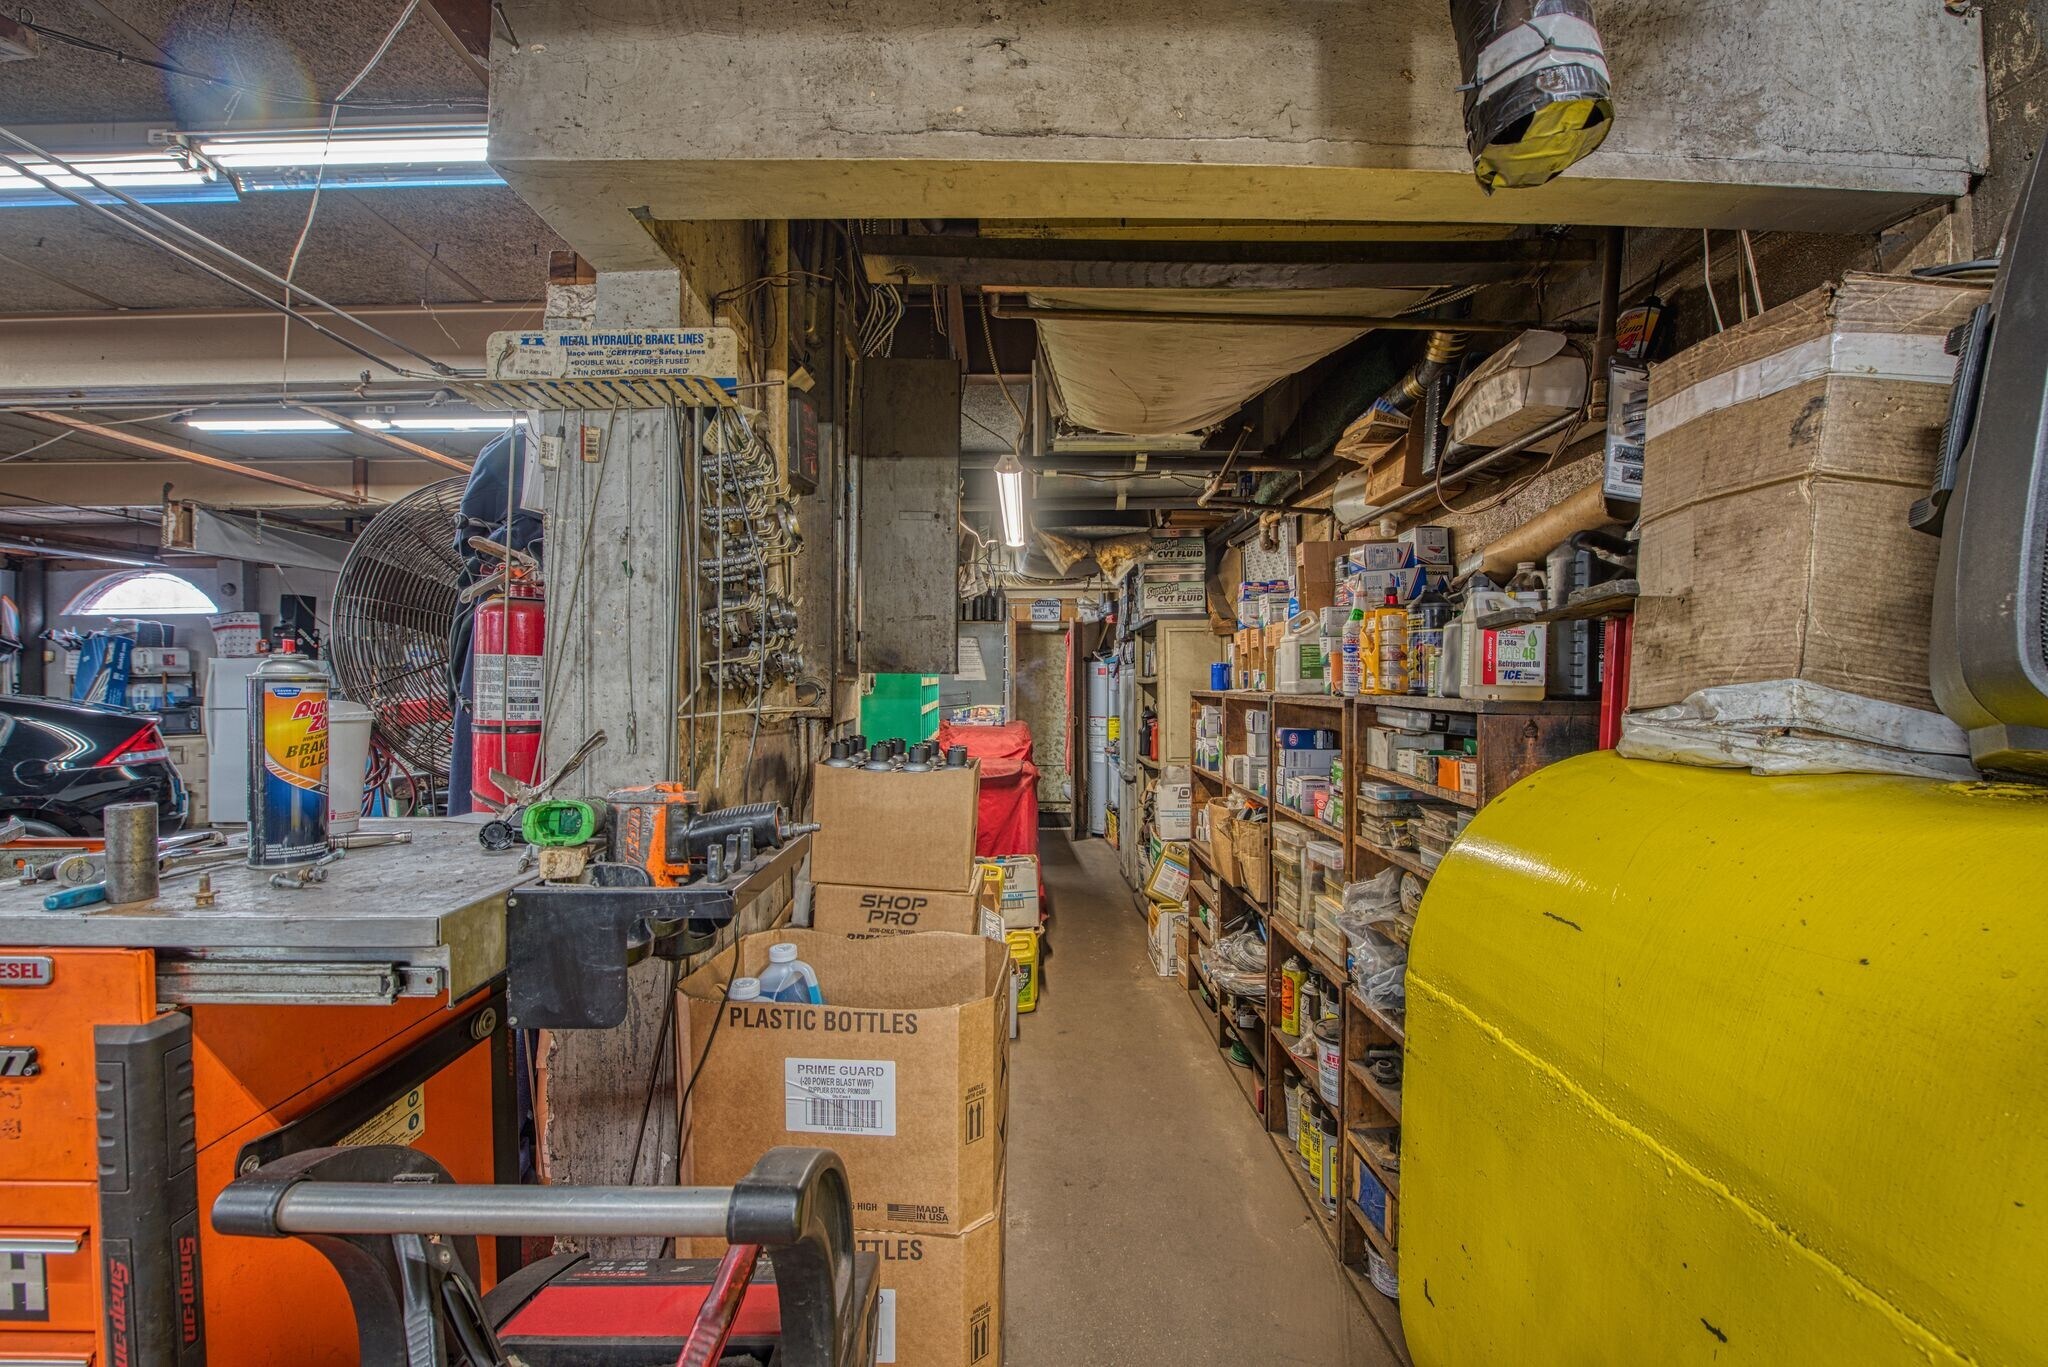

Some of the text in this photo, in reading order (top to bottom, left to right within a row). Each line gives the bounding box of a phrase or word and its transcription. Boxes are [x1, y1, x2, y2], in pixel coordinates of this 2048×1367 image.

[560, 334, 704, 346] METAL HYDRAULIC BRAKE LINES
[1177, 594, 1203, 602] FLUID
[1498, 646, 1536, 660] PAG 46
[1498, 660, 1531, 668] Refrigerant
[1504, 670, 1522, 680] ICE
[859, 894, 928, 910] SHOP
[867, 910, 918, 925] PRO
[730, 1006, 918, 1035] PLASTIC BOTTLES
[797, 1065, 884, 1076] PRIME GUARD
[812, 1078, 835, 1086] POWER
[836, 1079, 856, 1087] BLAST
[856, 1079, 874, 1088] WWF)
[968, 1083, 983, 1094] HANDLE
[976, 1088, 986, 1096] CARE
[858, 1203, 877, 1211] HIGH
[916, 1205, 944, 1214] MADE
